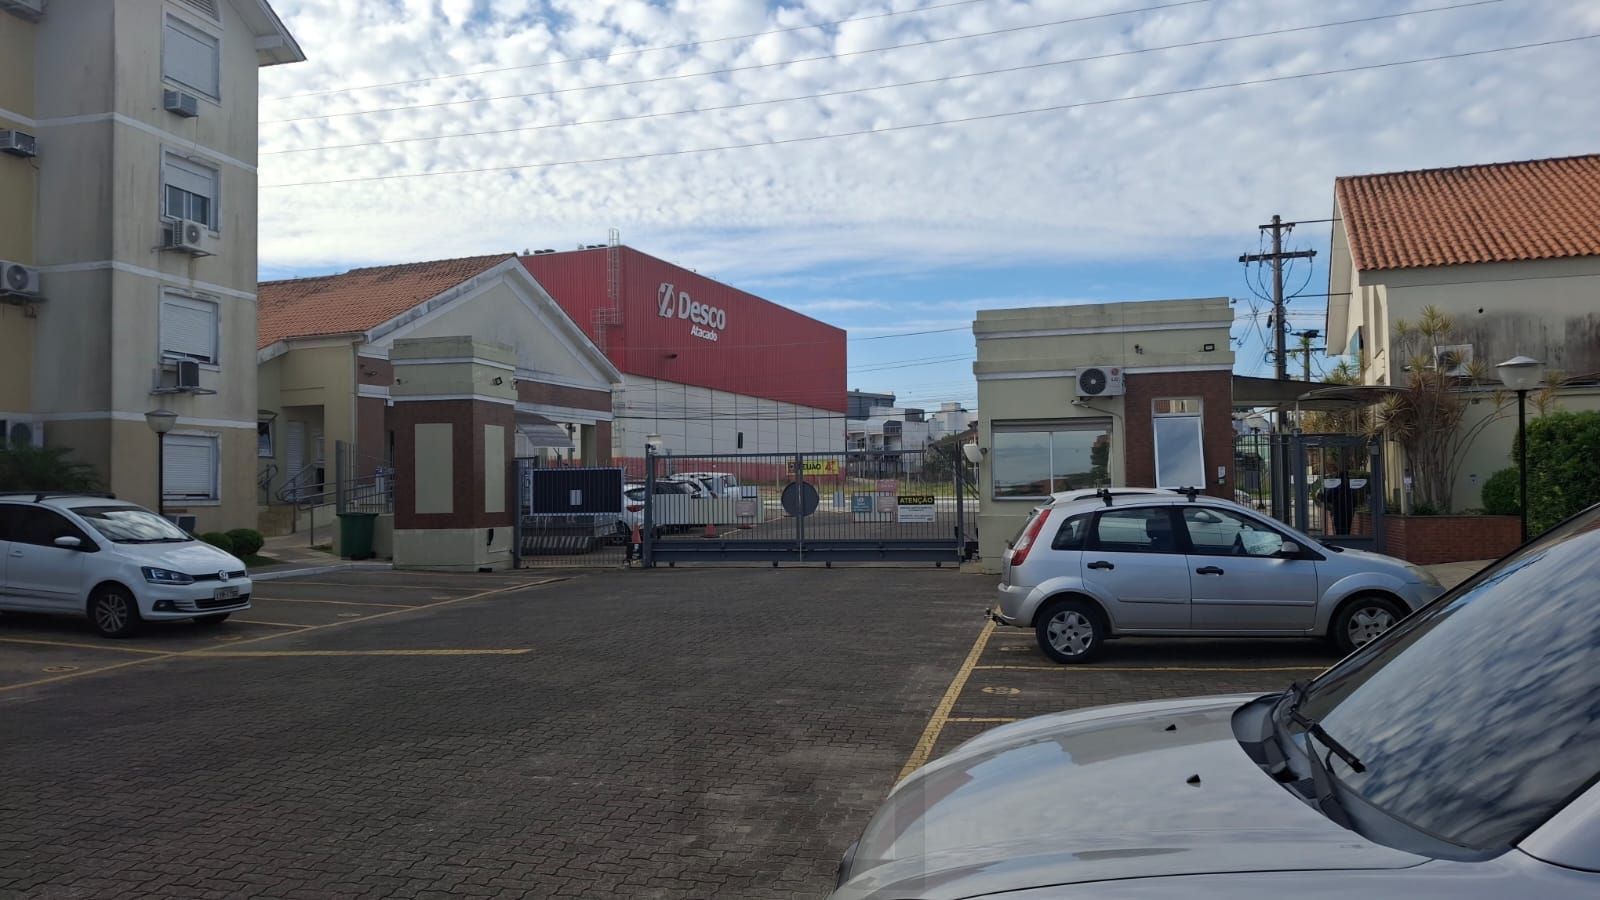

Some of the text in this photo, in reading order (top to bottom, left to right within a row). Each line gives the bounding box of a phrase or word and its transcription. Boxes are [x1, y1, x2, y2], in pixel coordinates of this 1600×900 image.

[678, 291, 726, 330] Desco
[690, 324, 718, 341] Atacado
[899, 496, 933, 504] ATENÇÃO
